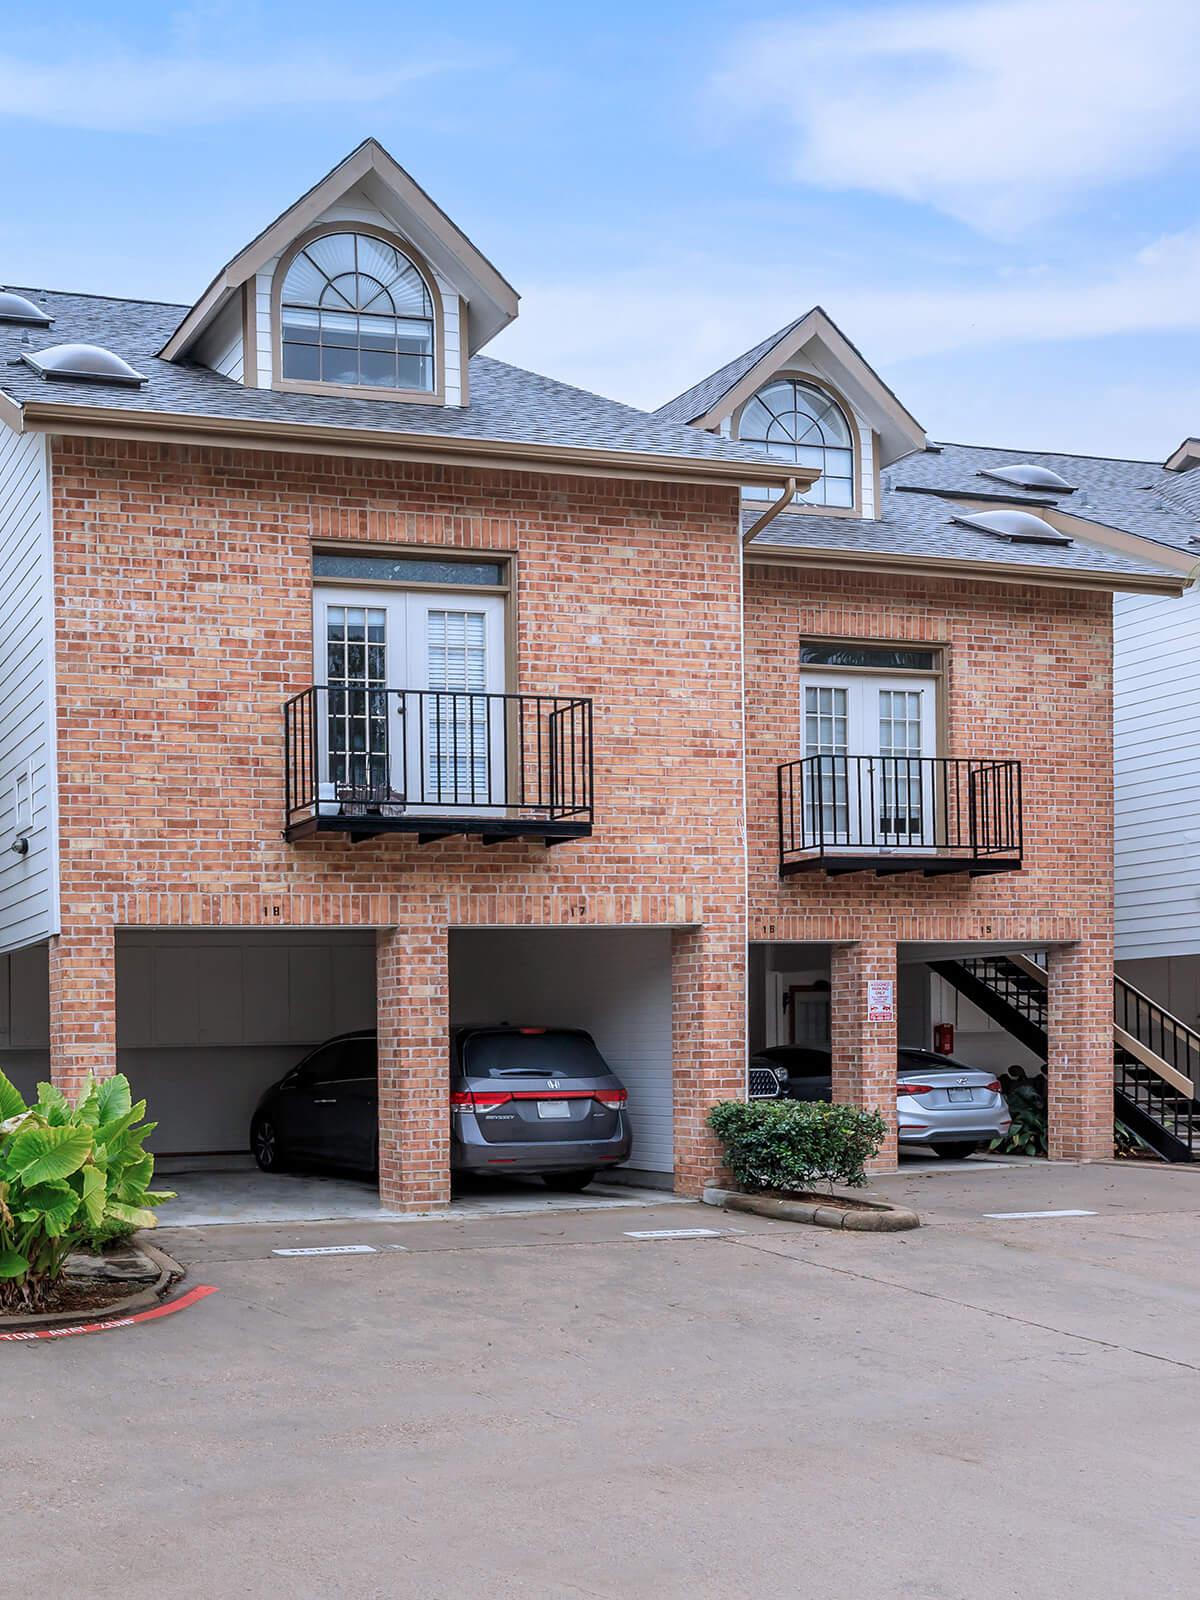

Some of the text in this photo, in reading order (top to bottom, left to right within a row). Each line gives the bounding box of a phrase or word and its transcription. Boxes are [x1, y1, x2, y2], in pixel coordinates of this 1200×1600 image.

[264, 906, 280, 917] 18
[571, 906, 585, 917] 17
[981, 925, 992, 935] 15
[0, 1331, 39, 1341] TOW
[48, 1326, 87, 1337] AWAY
